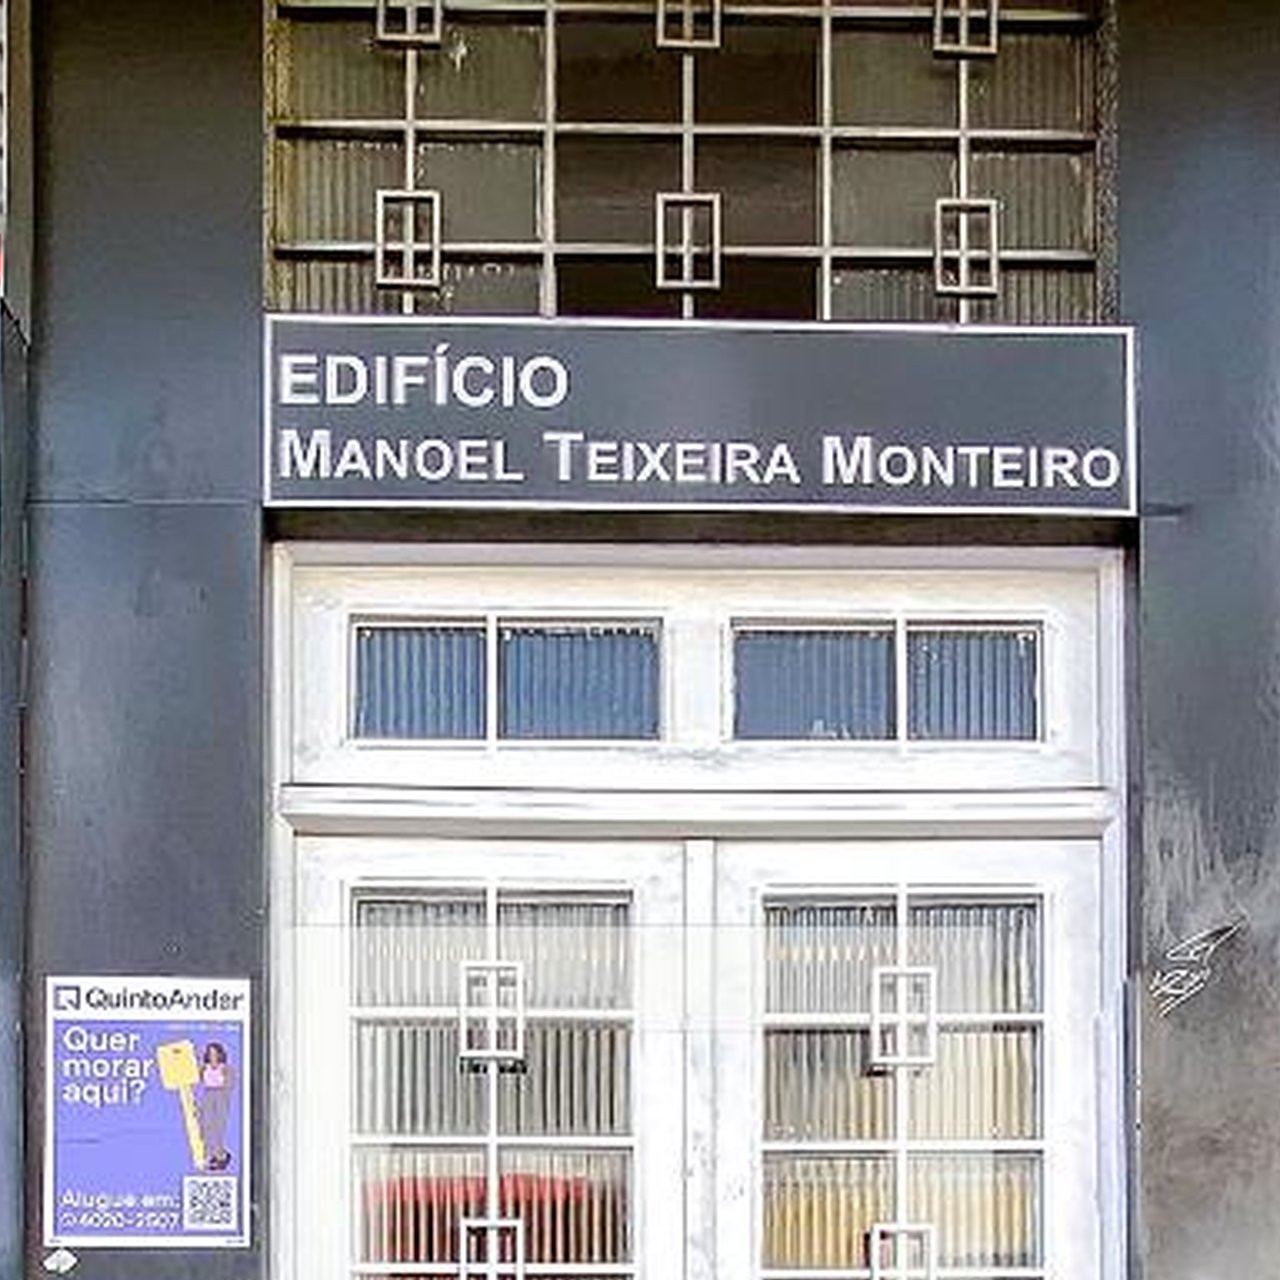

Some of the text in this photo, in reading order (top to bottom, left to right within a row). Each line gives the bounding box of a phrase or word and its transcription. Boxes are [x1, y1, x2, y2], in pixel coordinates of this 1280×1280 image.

[278, 343, 570, 408] EDIFÍCIO
[278, 427, 1122, 490] MANOEL TEIXEIRA MONTEIRO
[63, 1026, 140, 1052] Quer
[63, 1057, 155, 1078] morar
[62, 1079, 145, 1108] aqui?
